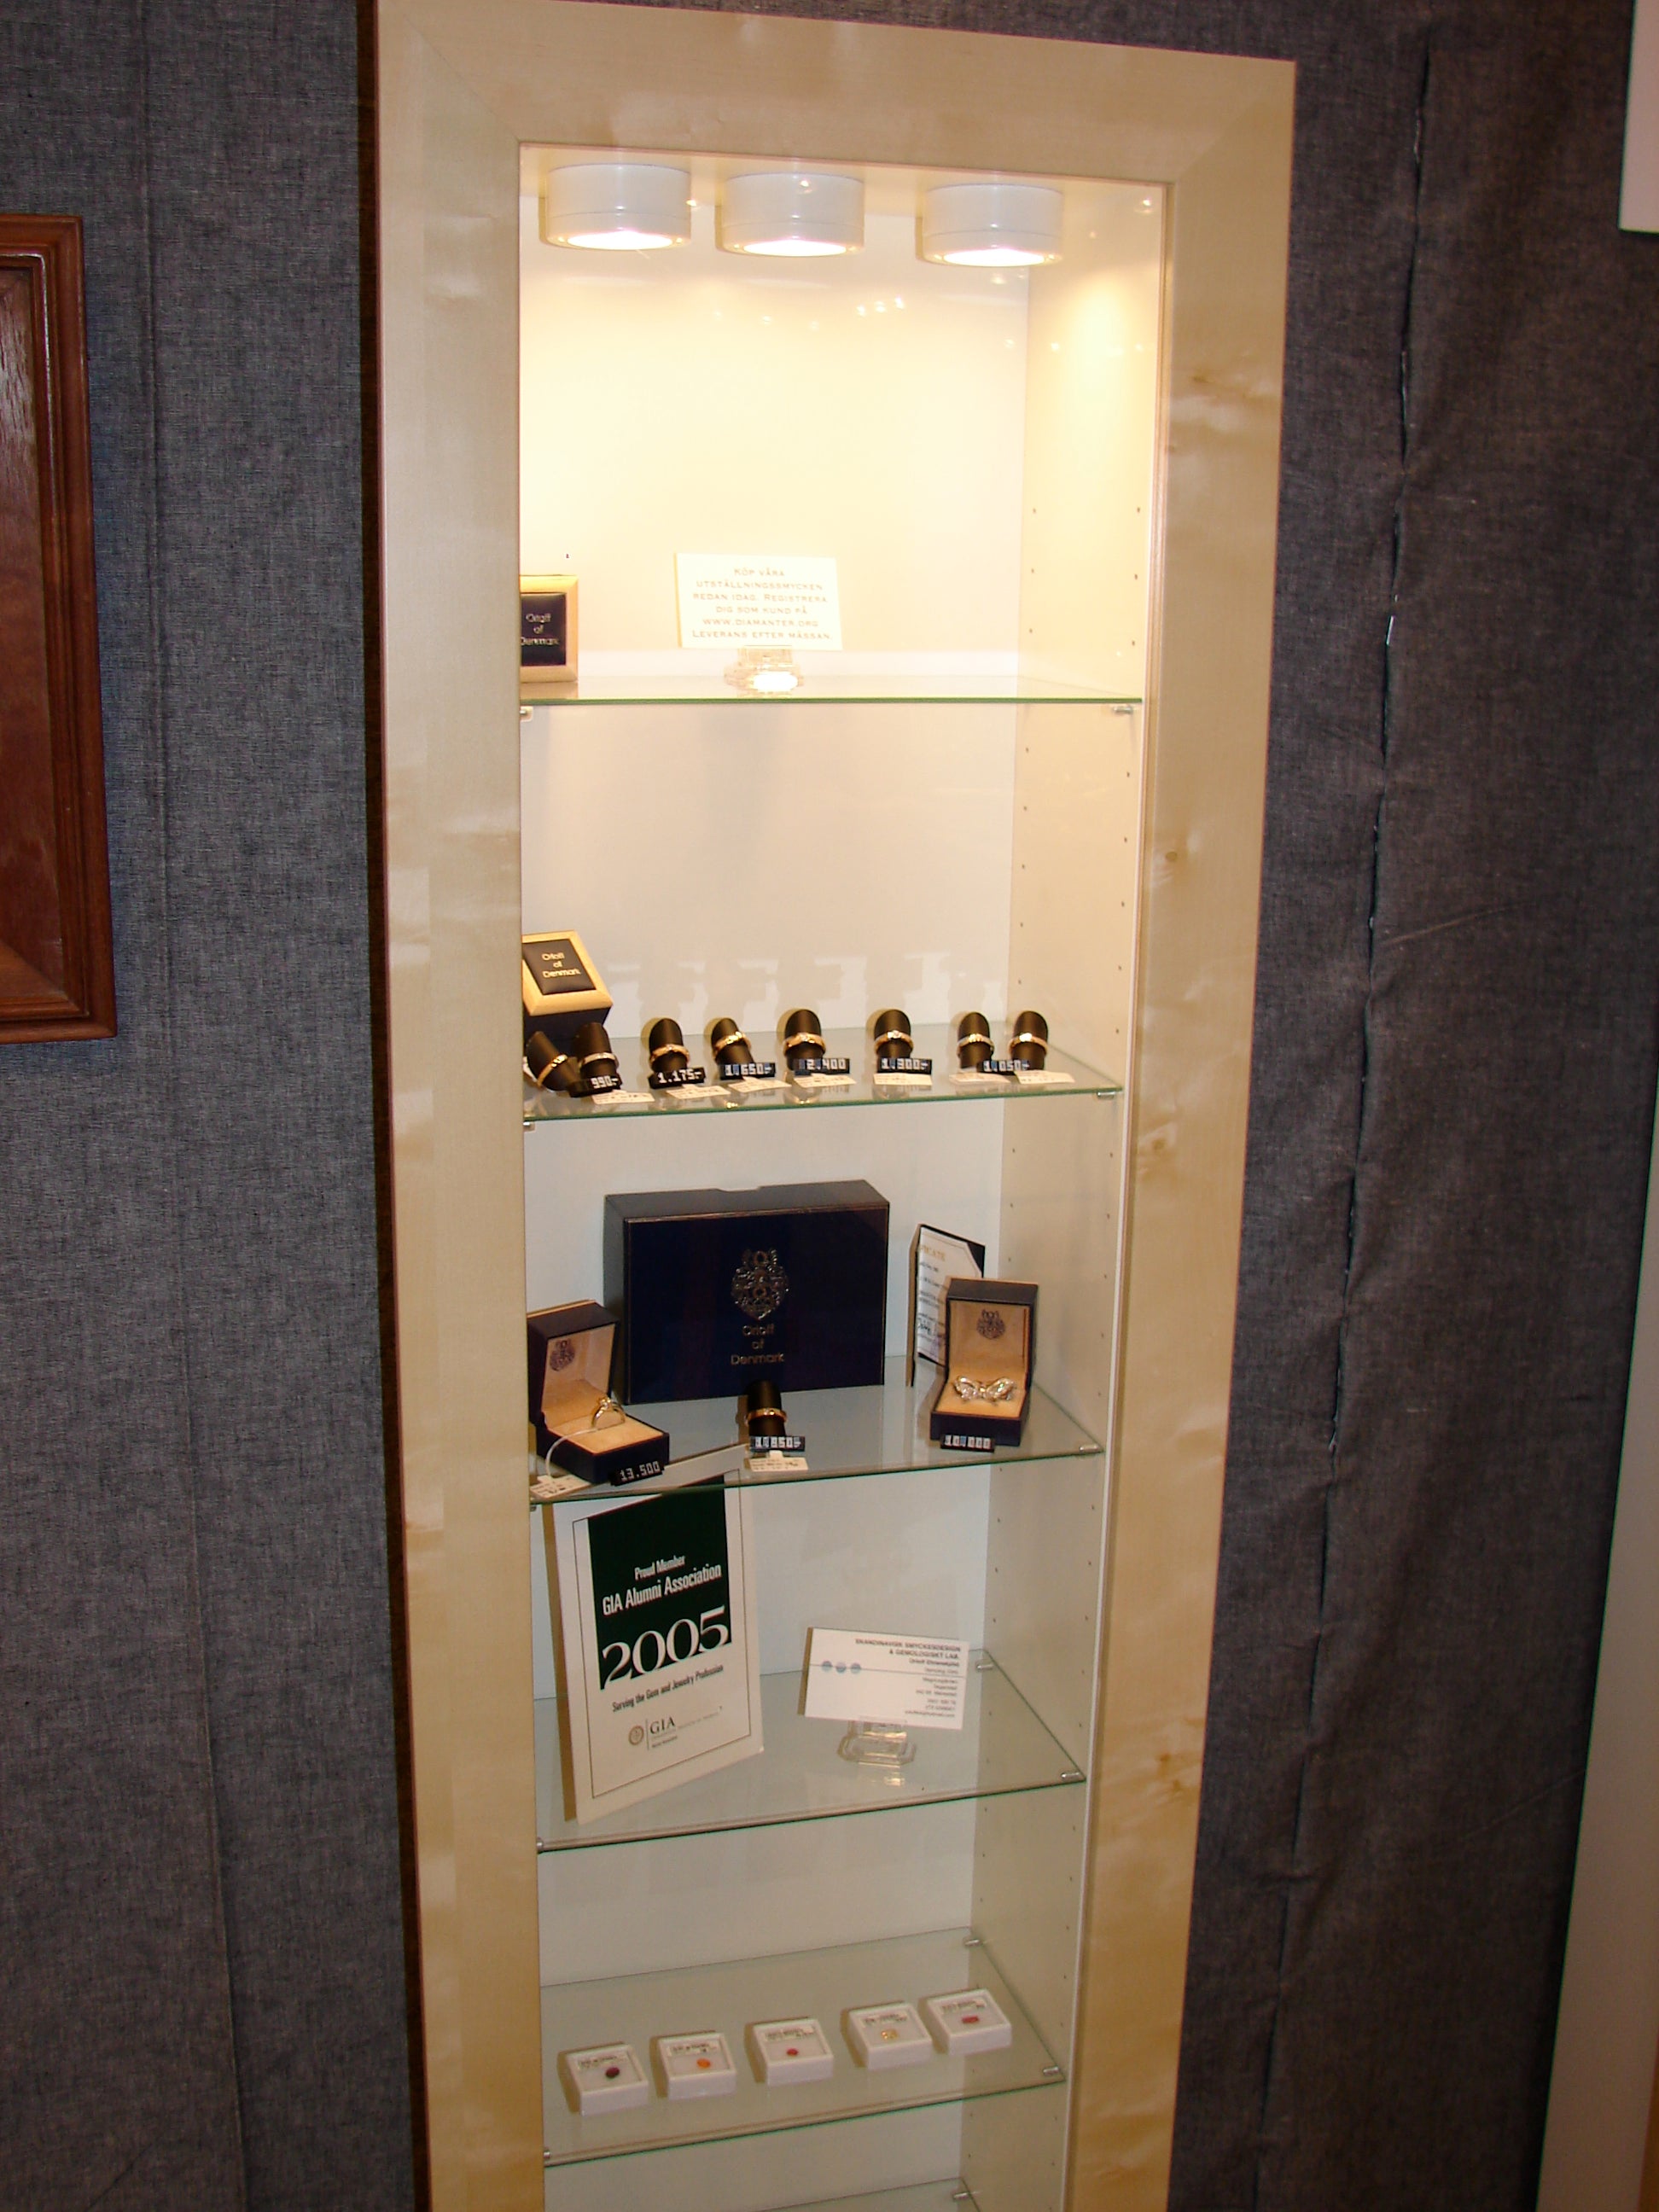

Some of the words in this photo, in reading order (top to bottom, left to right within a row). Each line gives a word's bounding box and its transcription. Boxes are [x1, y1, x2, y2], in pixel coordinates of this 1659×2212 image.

[734, 568, 755, 576] KÖP
[759, 567, 785, 576] VÅRA
[764, 593, 828, 602] REGISTRERA
[795, 605, 807, 614] PÅ
[533, 625, 544, 634] of
[692, 630, 748, 639] LEVERANS
[542, 968, 581, 979] Denmark
[751, 1338, 765, 1349] of
[731, 1353, 785, 1365] Denmark
[620, 1460, 661, 1481] 13.500
[634, 1562, 655, 1580] Proud
[656, 1555, 686, 1574] Member
[602, 1592, 624, 1616] GIA
[626, 1579, 662, 1610] Alumni
[664, 1563, 722, 1596] Association
[602, 1604, 729, 1691] 2005
[612, 1697, 634, 1713] Serving
[635, 1693, 645, 1704] the
[646, 1688, 660, 1700] Gem
[661, 1682, 671, 1695] and
[672, 1675, 695, 1690] Jewelry
[695, 1664, 724, 1681] Profession
[649, 1716, 676, 1735] GIA
